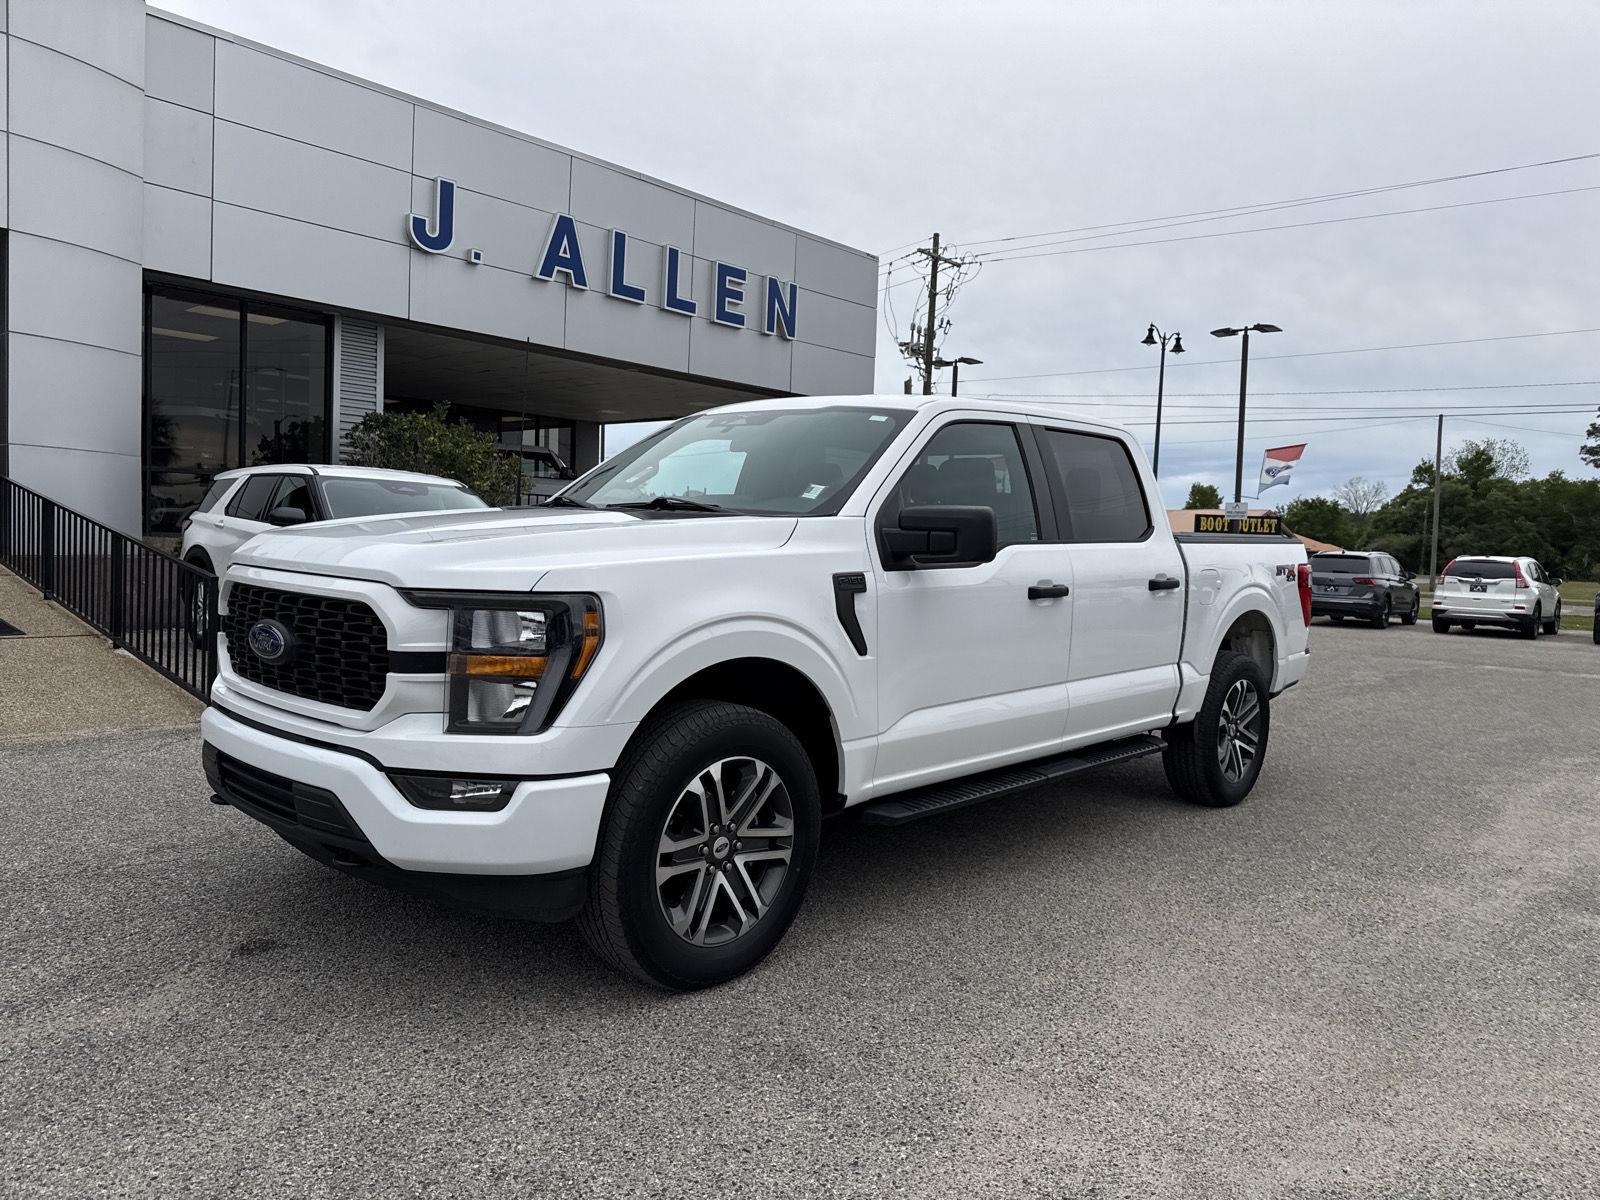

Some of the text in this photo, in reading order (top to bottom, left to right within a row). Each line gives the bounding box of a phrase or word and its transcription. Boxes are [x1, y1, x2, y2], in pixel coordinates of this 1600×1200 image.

[407, 176, 798, 340] J. ALLEN
[1200, 516, 1277, 533] BOOT UTLET
[253, 630, 274, 651] Ford
